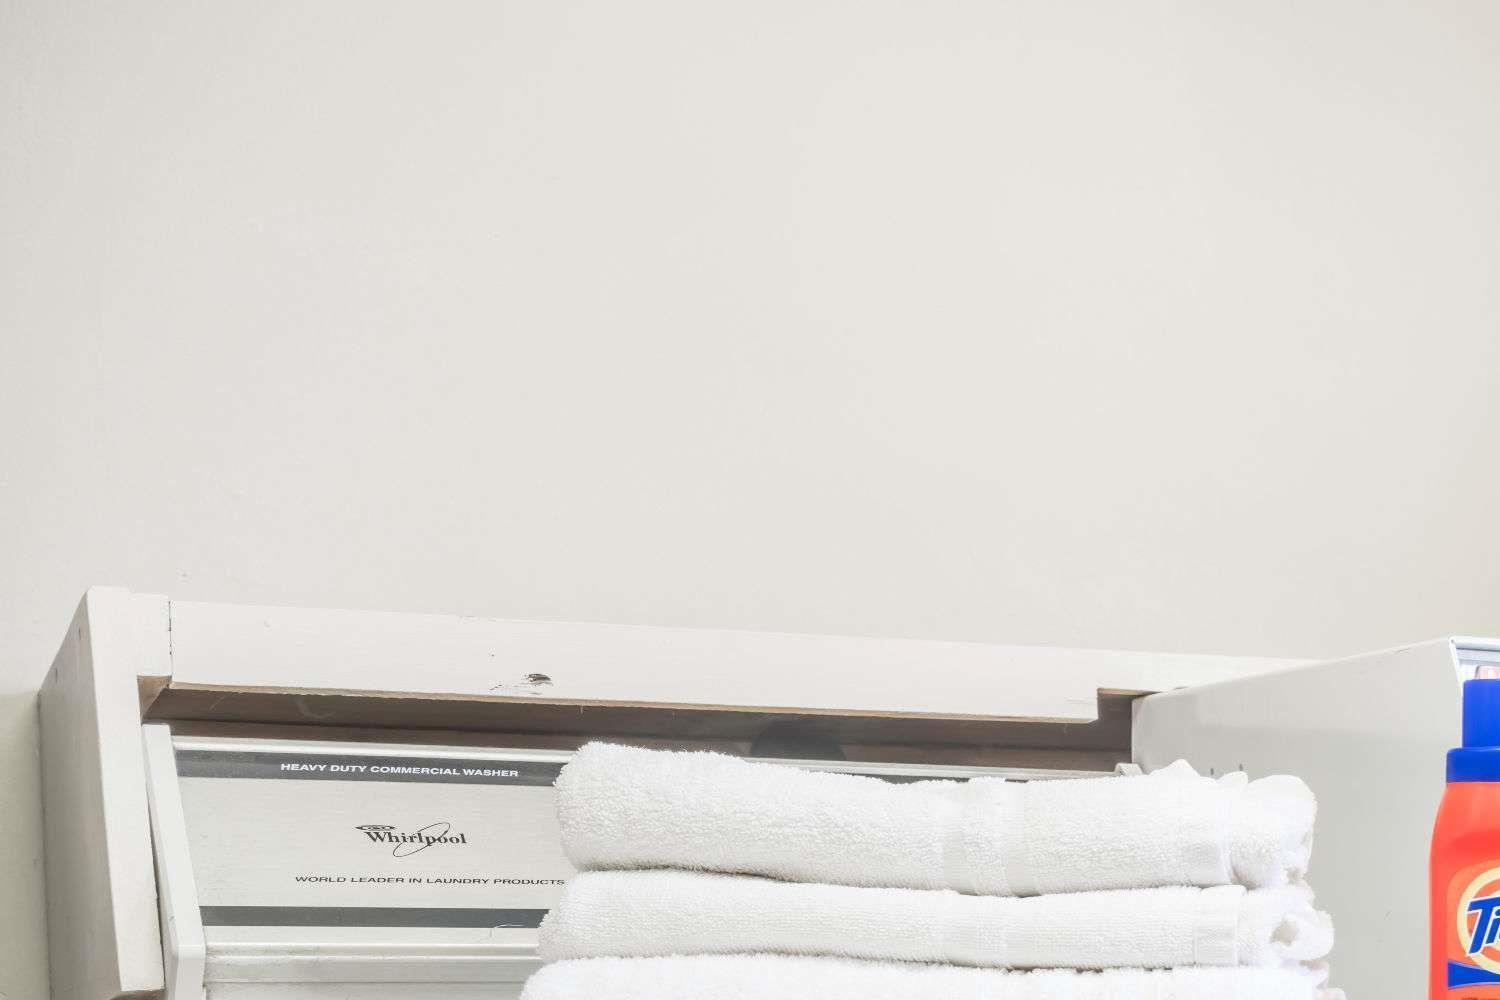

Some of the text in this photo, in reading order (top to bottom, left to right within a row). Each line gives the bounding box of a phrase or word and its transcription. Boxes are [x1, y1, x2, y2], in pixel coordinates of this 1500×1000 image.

[280, 763, 519, 777] HEAVY DUTY COMMERCIAL WASHER
[364, 831, 467, 847] Whirlpool
[351, 876, 404, 884] LEADER
